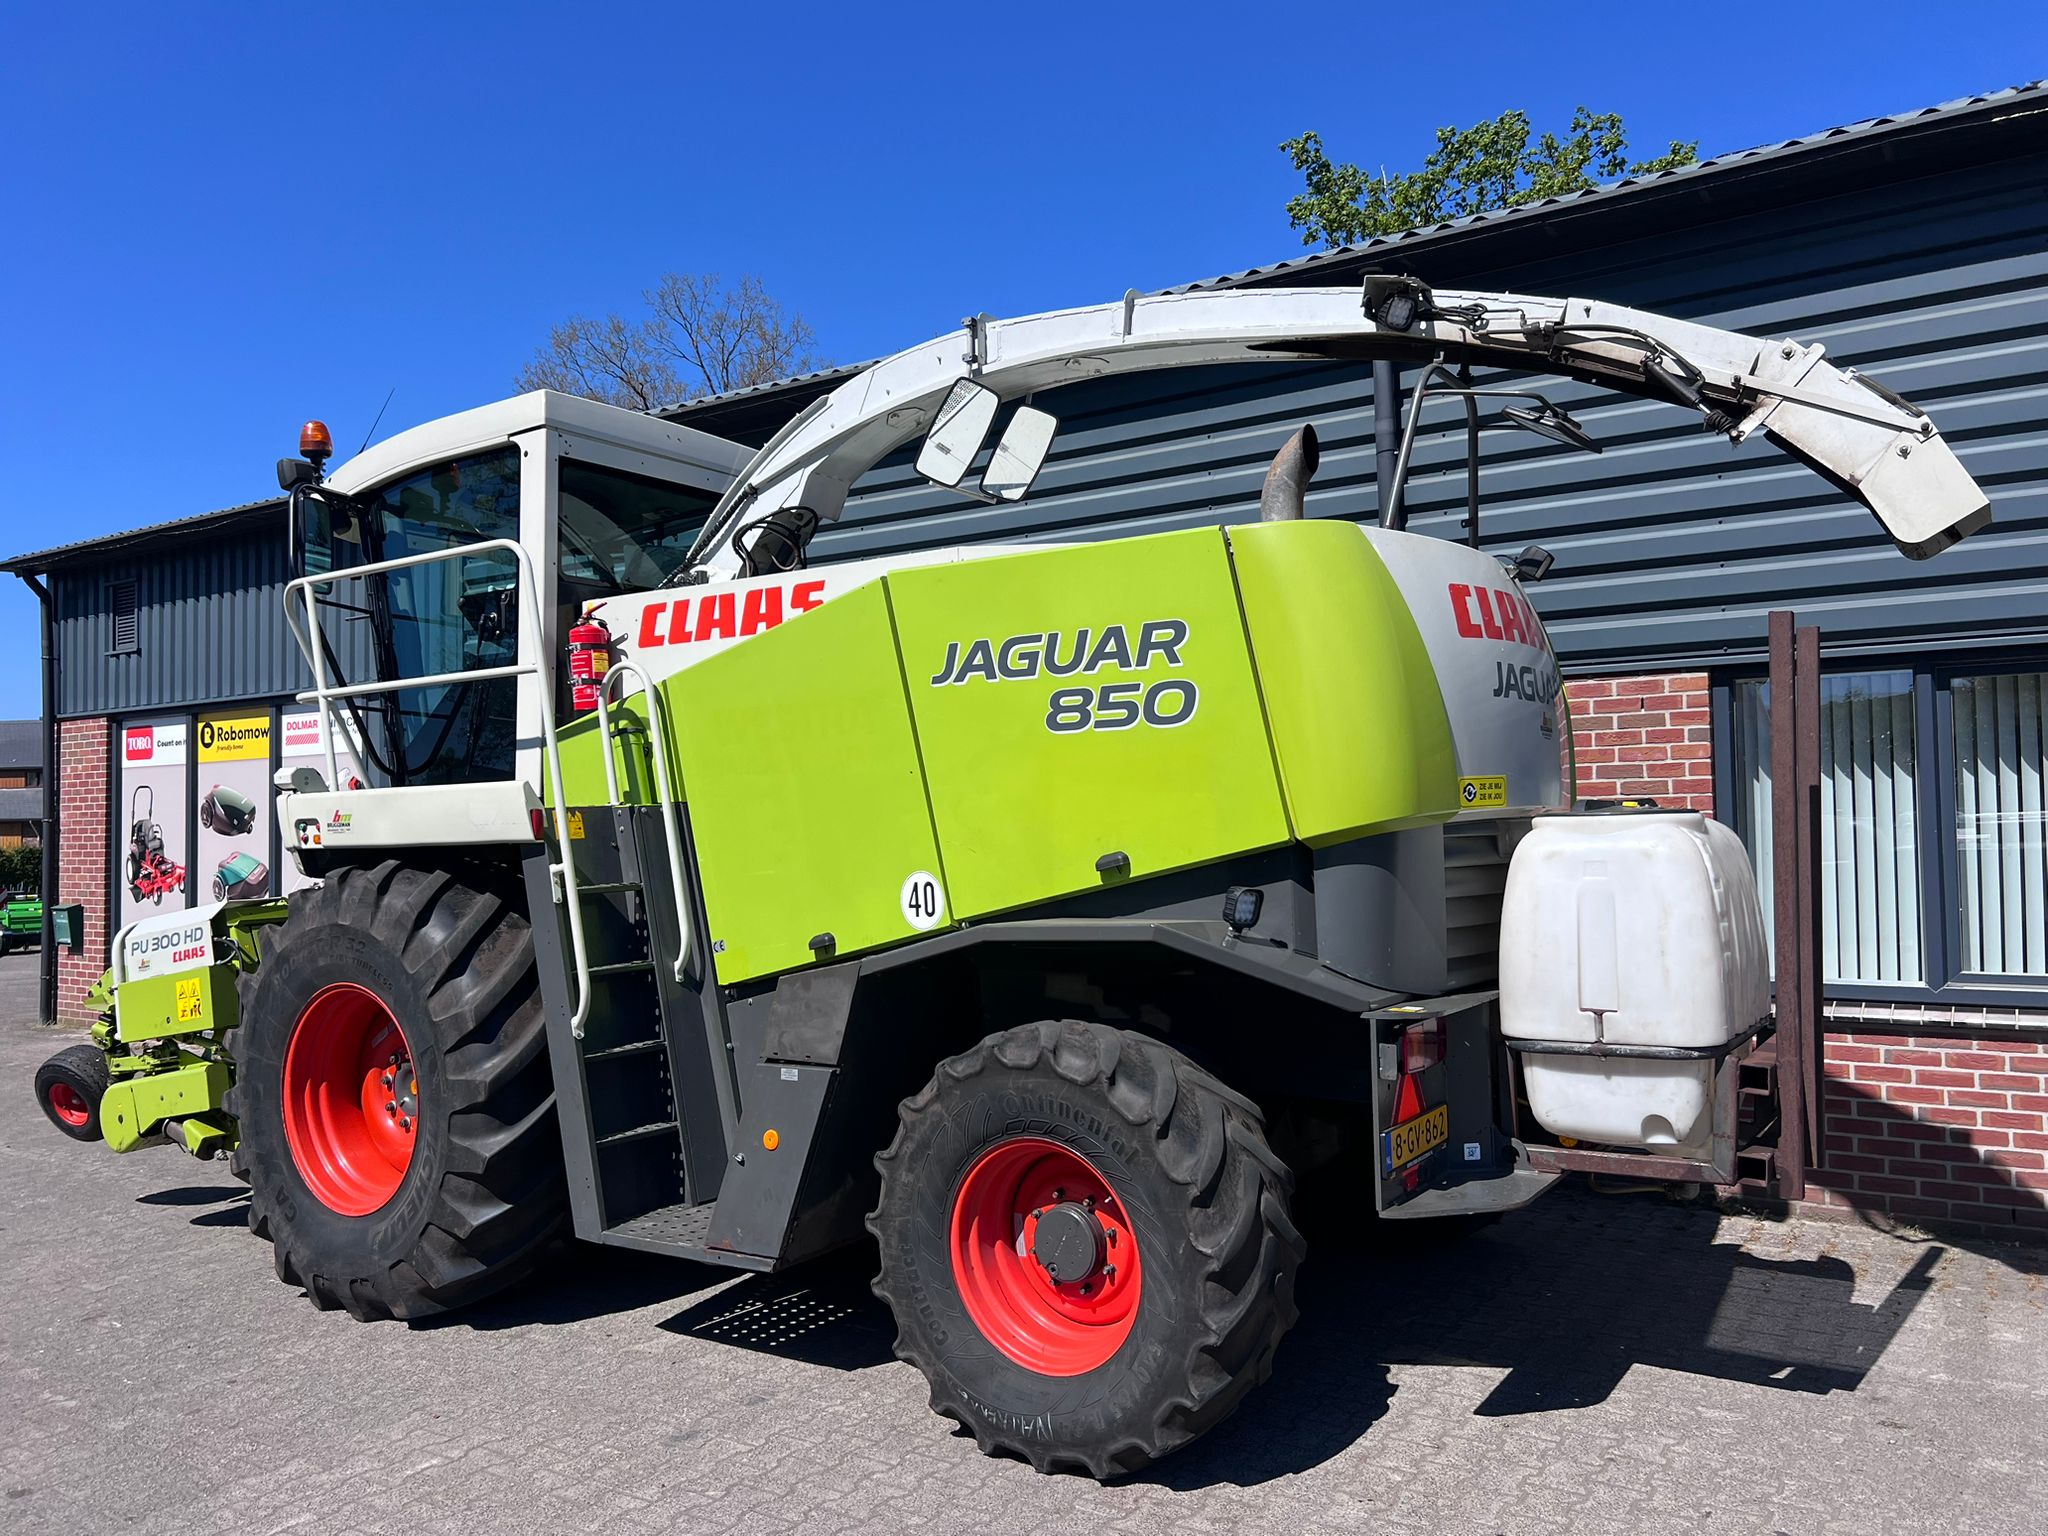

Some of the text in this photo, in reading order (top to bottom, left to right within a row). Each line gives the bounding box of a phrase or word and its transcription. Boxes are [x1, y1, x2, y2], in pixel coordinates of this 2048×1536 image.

[1448, 583, 1548, 652] CLAA
[931, 619, 1187, 686] JAGUAR
[1045, 680, 1198, 734] 850
[217, 725, 270, 742] Robomow
[286, 720, 318, 731] DOLMAR
[157, 739, 174, 748] Count
[908, 881, 936, 918] 40
[132, 926, 204, 956] PU 300 HD
[173, 945, 206, 964] CLAAS
